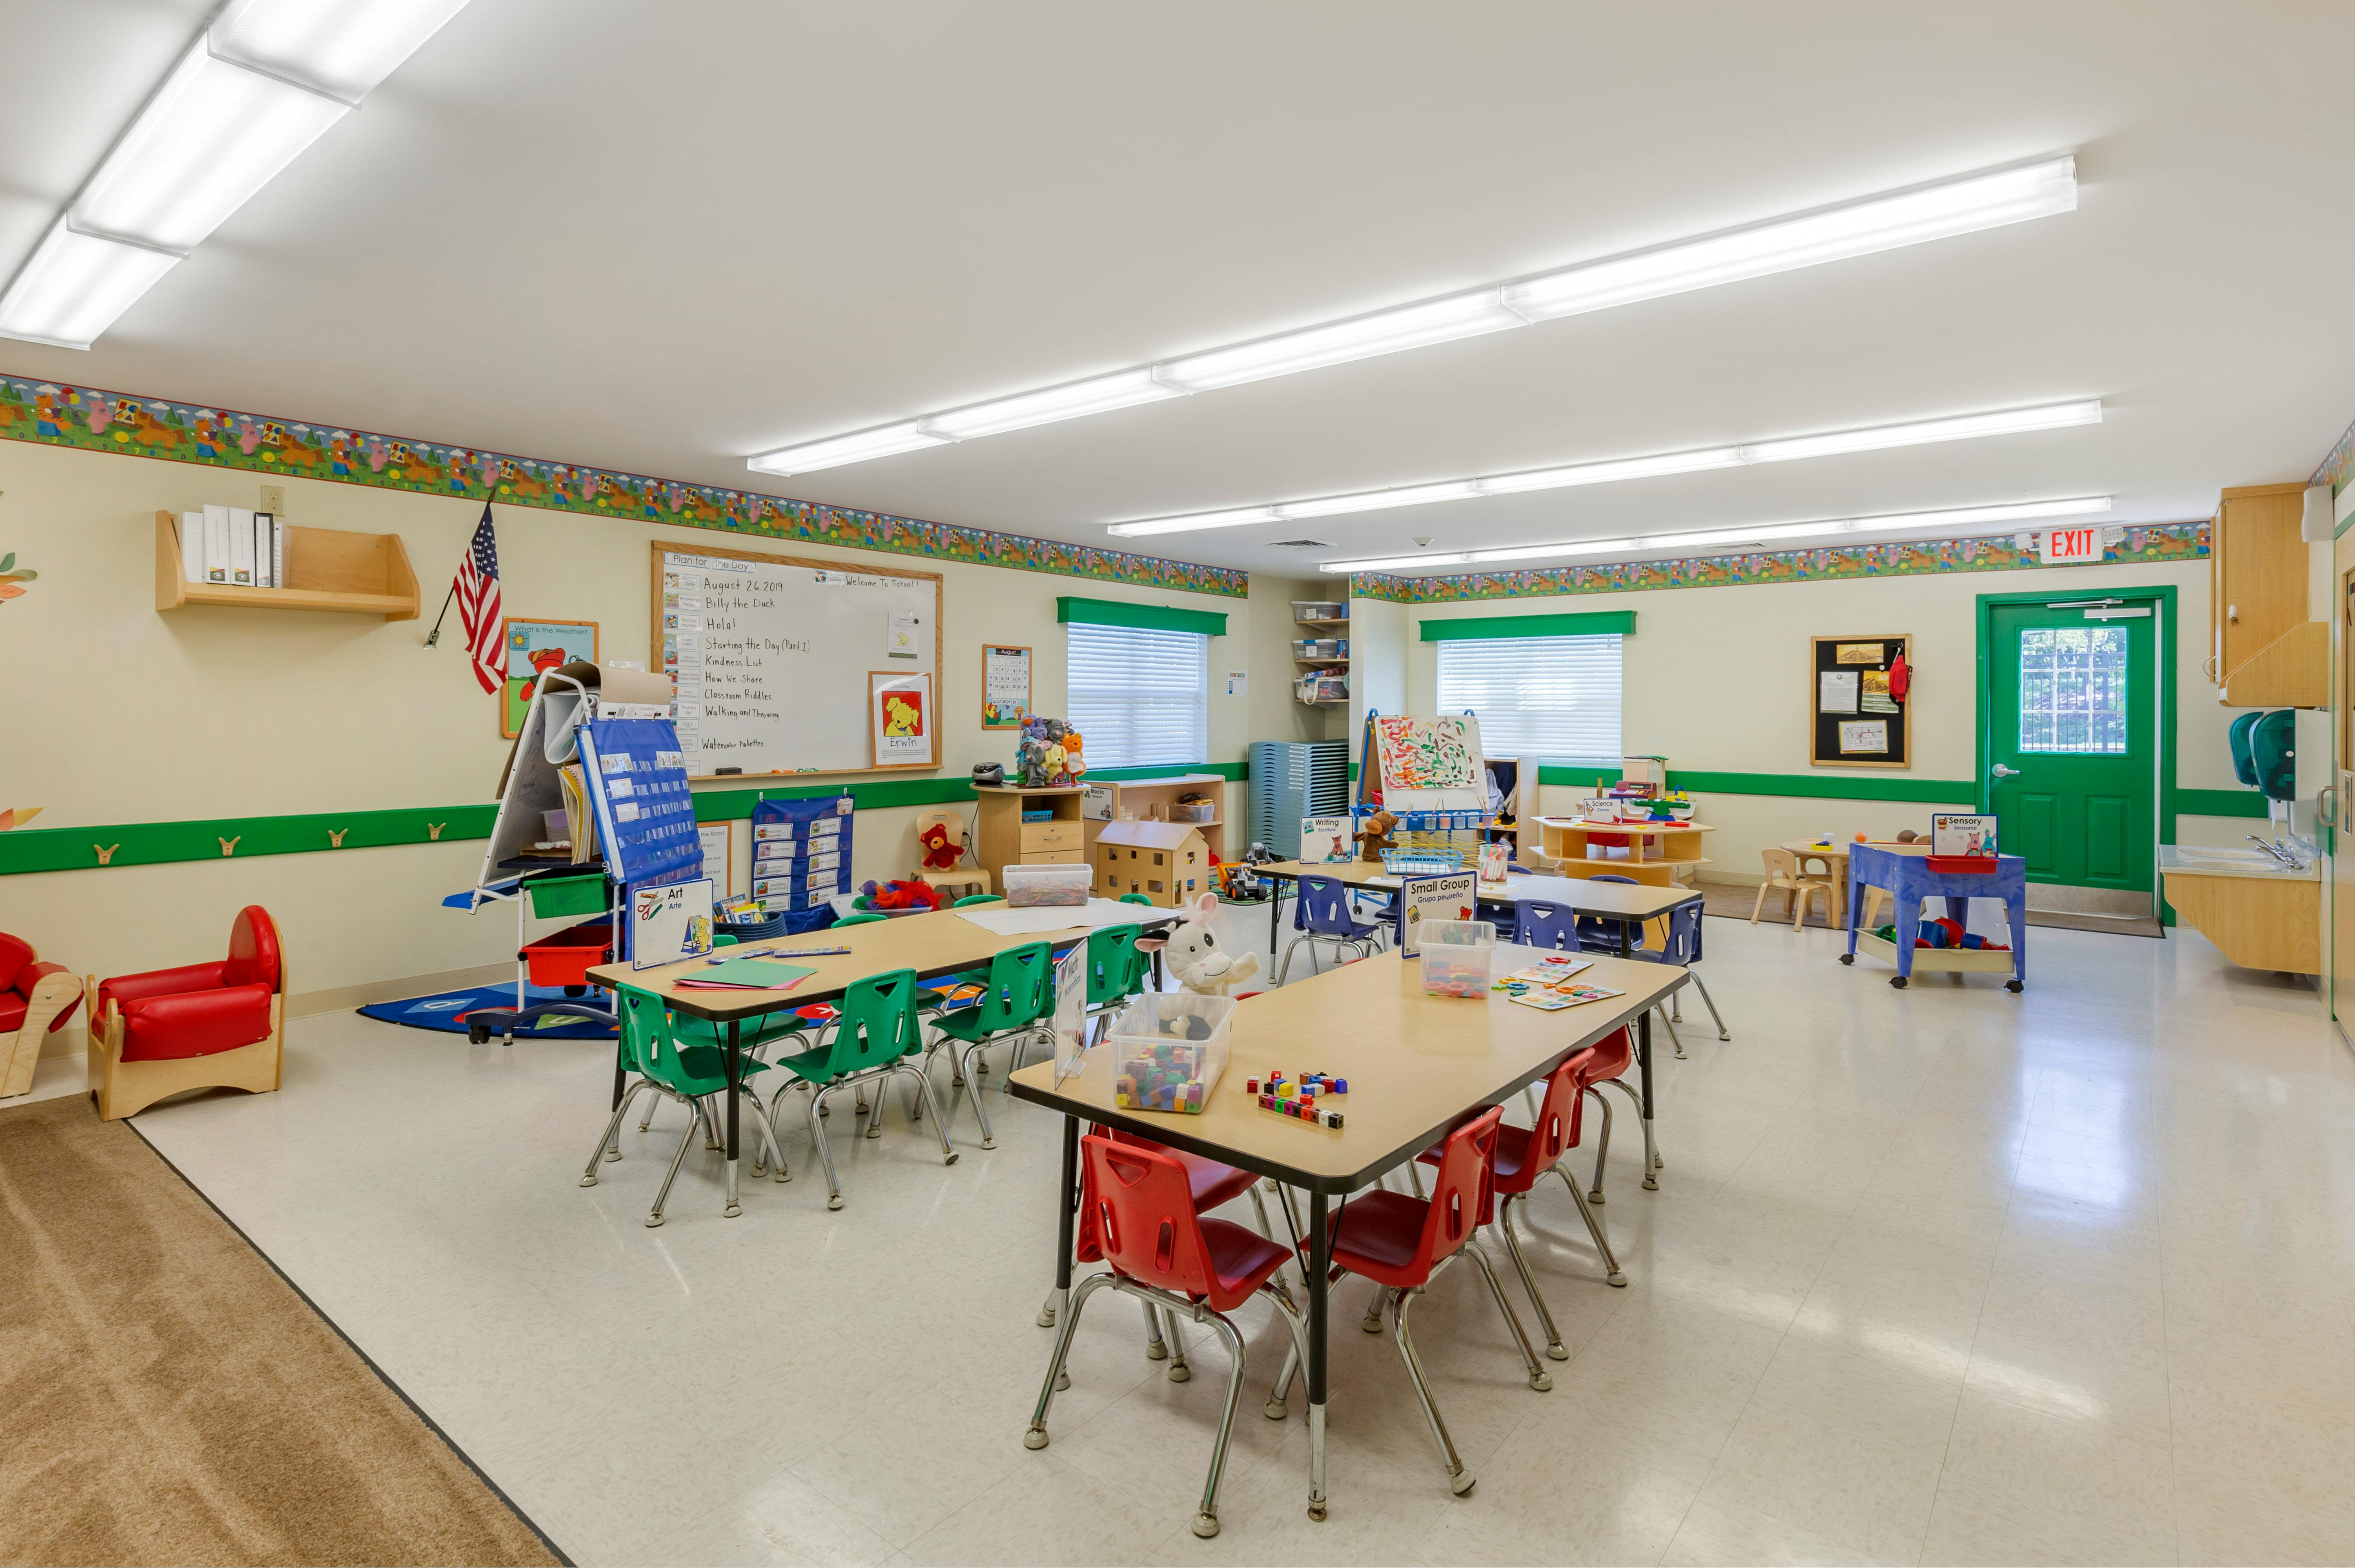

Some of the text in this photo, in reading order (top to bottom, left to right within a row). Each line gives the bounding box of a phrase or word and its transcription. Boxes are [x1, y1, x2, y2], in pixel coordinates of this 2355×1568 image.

[2052, 530, 2094, 557] EXIT
[674, 554, 748, 571] Plan for the Day
[704, 578, 741, 595] August
[846, 575, 876, 587] Welcome
[879, 578, 888, 588] To
[706, 597, 729, 613] Billy
[733, 597, 748, 608] the
[754, 599, 775, 608] Duck
[707, 617, 735, 630] Hola!
[706, 637, 810, 656] Starting the Day (Part 1)
[705, 654, 762, 667] Kindness List
[705, 671, 763, 683] How We Share
[705, 689, 772, 700] Classroom Riddles
[705, 705, 737, 721] Walking
[752, 709, 779, 722] Throwing
[702, 738, 764, 750] Watercolor Palettes
[890, 737, 917, 747] Erwin
[1315, 819, 1339, 827] Writing
[1949, 817, 1982, 825] Sensory
[1411, 879, 1470, 894] Small Group
[668, 887, 683, 900] Art
[1437, 892, 1463, 902] pequeño
[1068, 955, 1078, 978] Math
